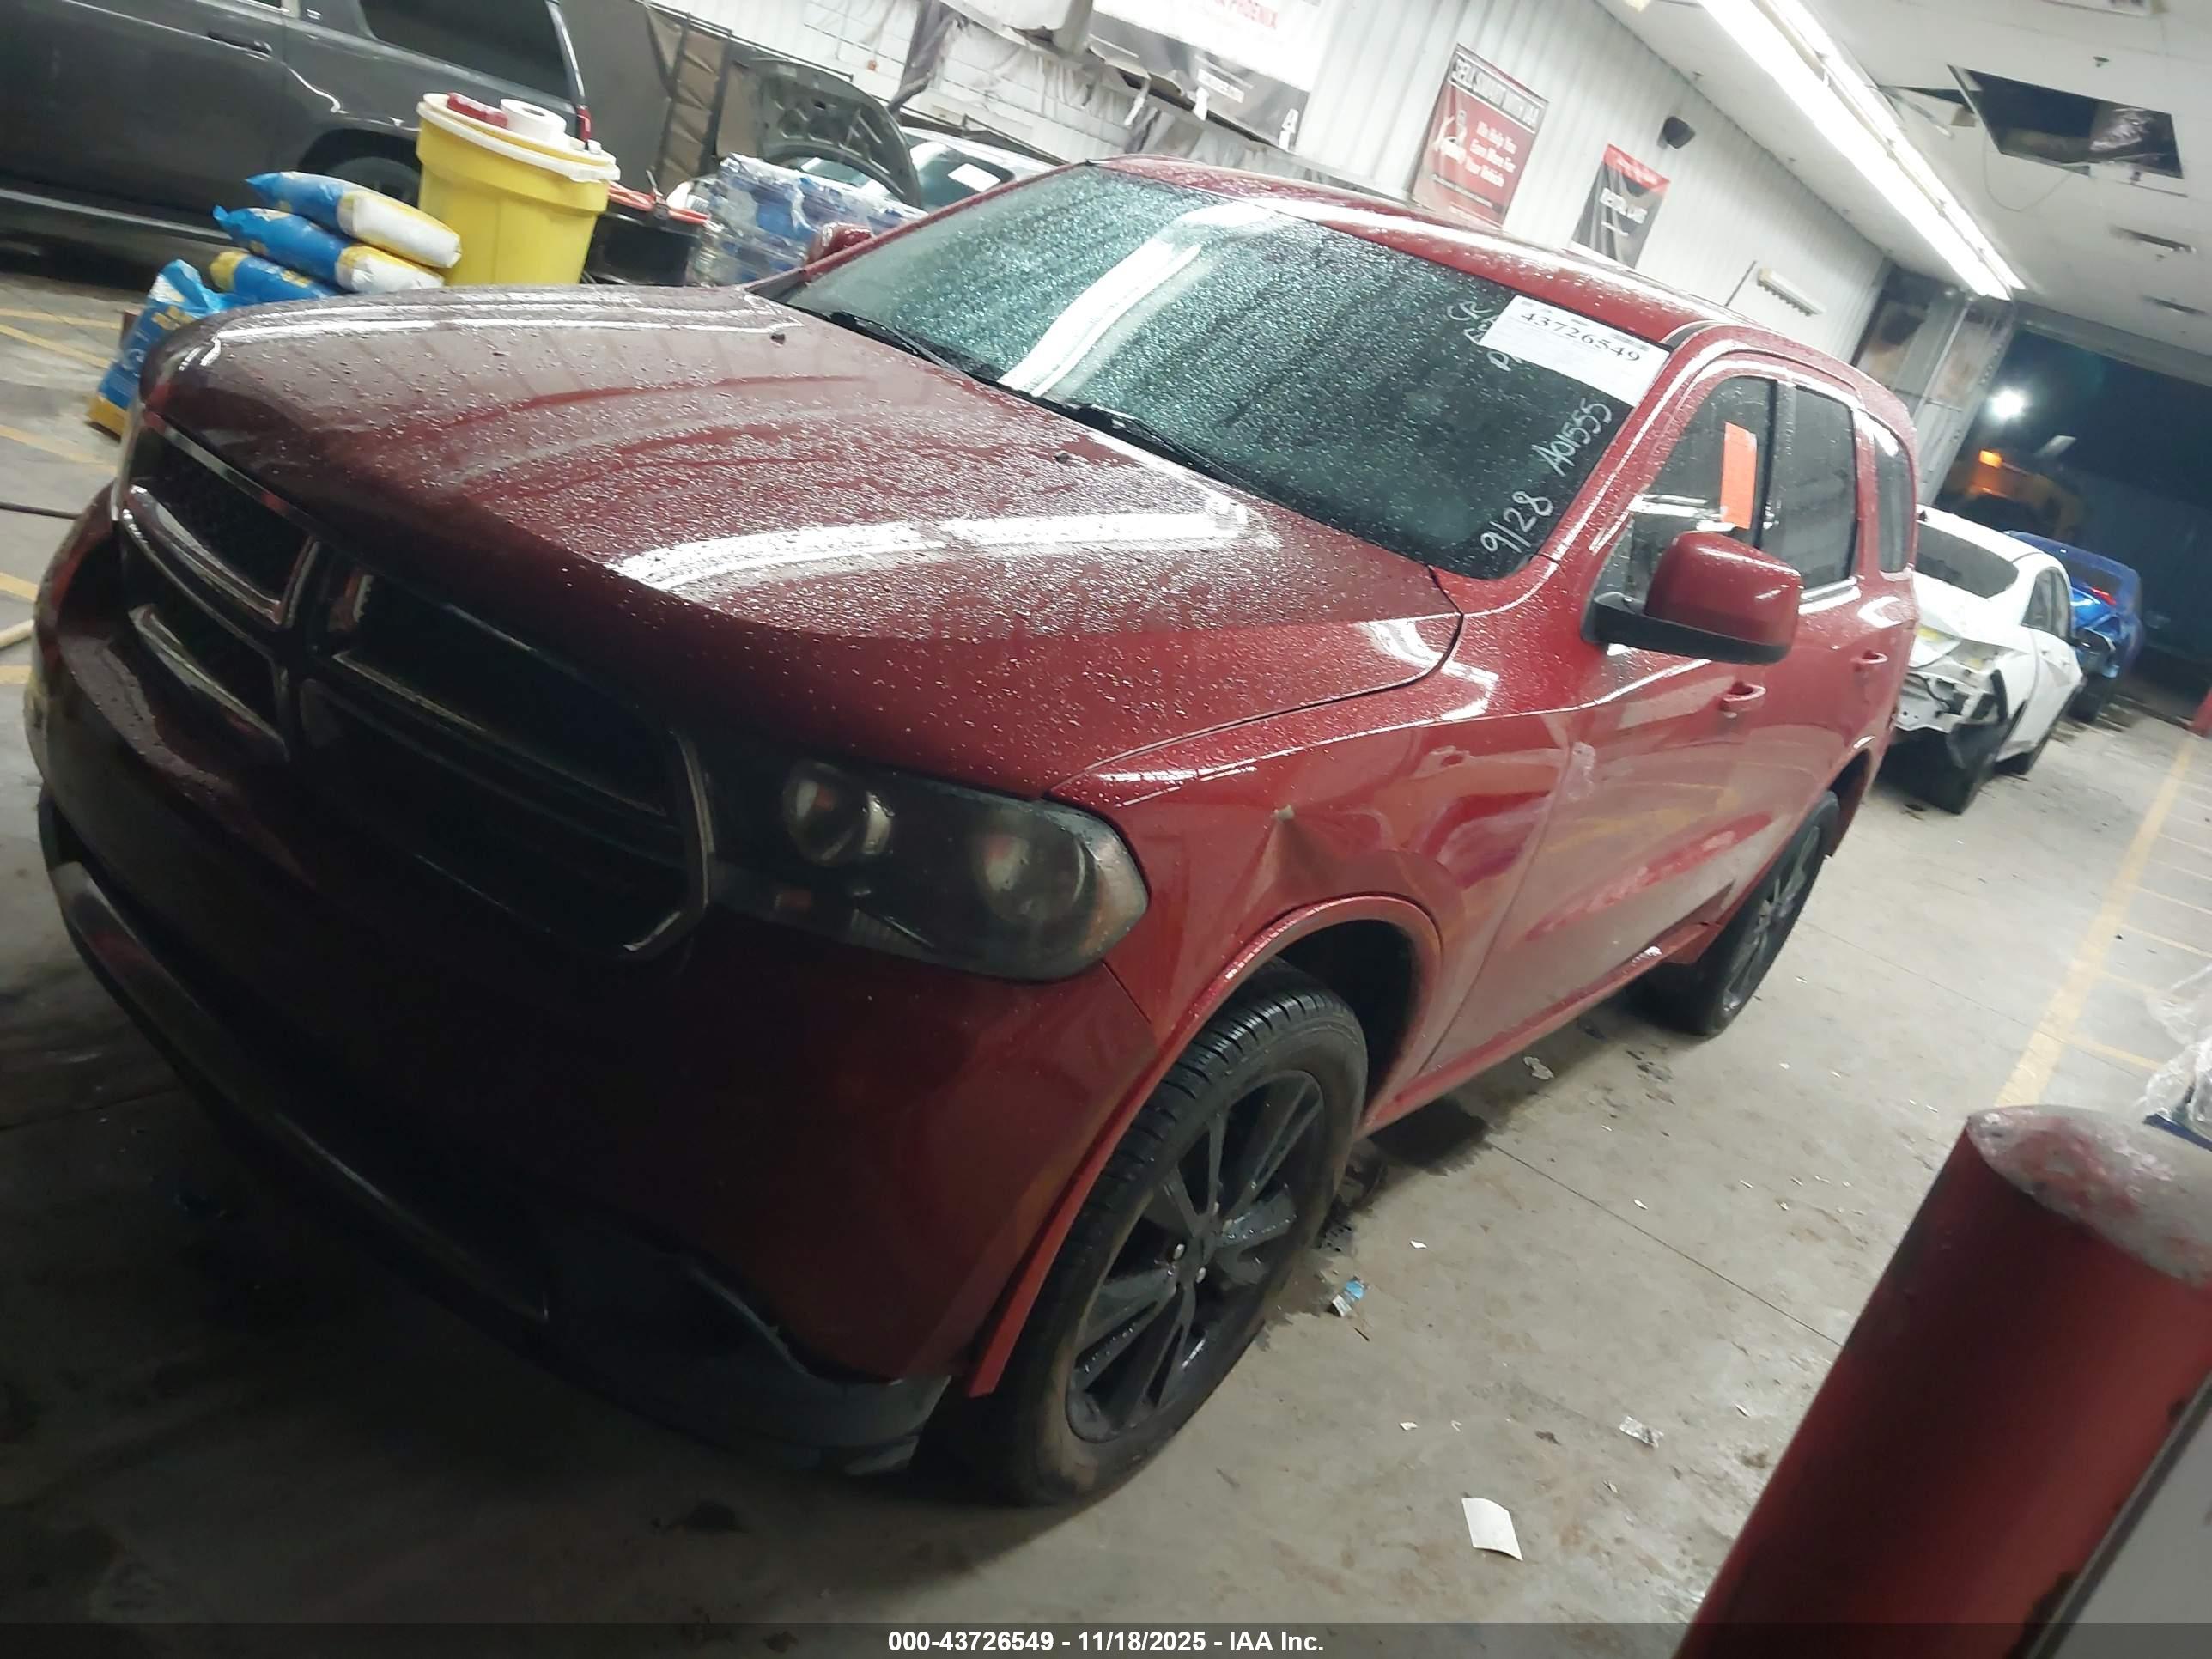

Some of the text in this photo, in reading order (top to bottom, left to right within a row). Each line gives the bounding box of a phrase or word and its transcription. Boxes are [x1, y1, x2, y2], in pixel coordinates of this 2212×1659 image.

[1520, 312, 1641, 362] 43726549
[1480, 398, 1612, 553] 9/28 A01555
